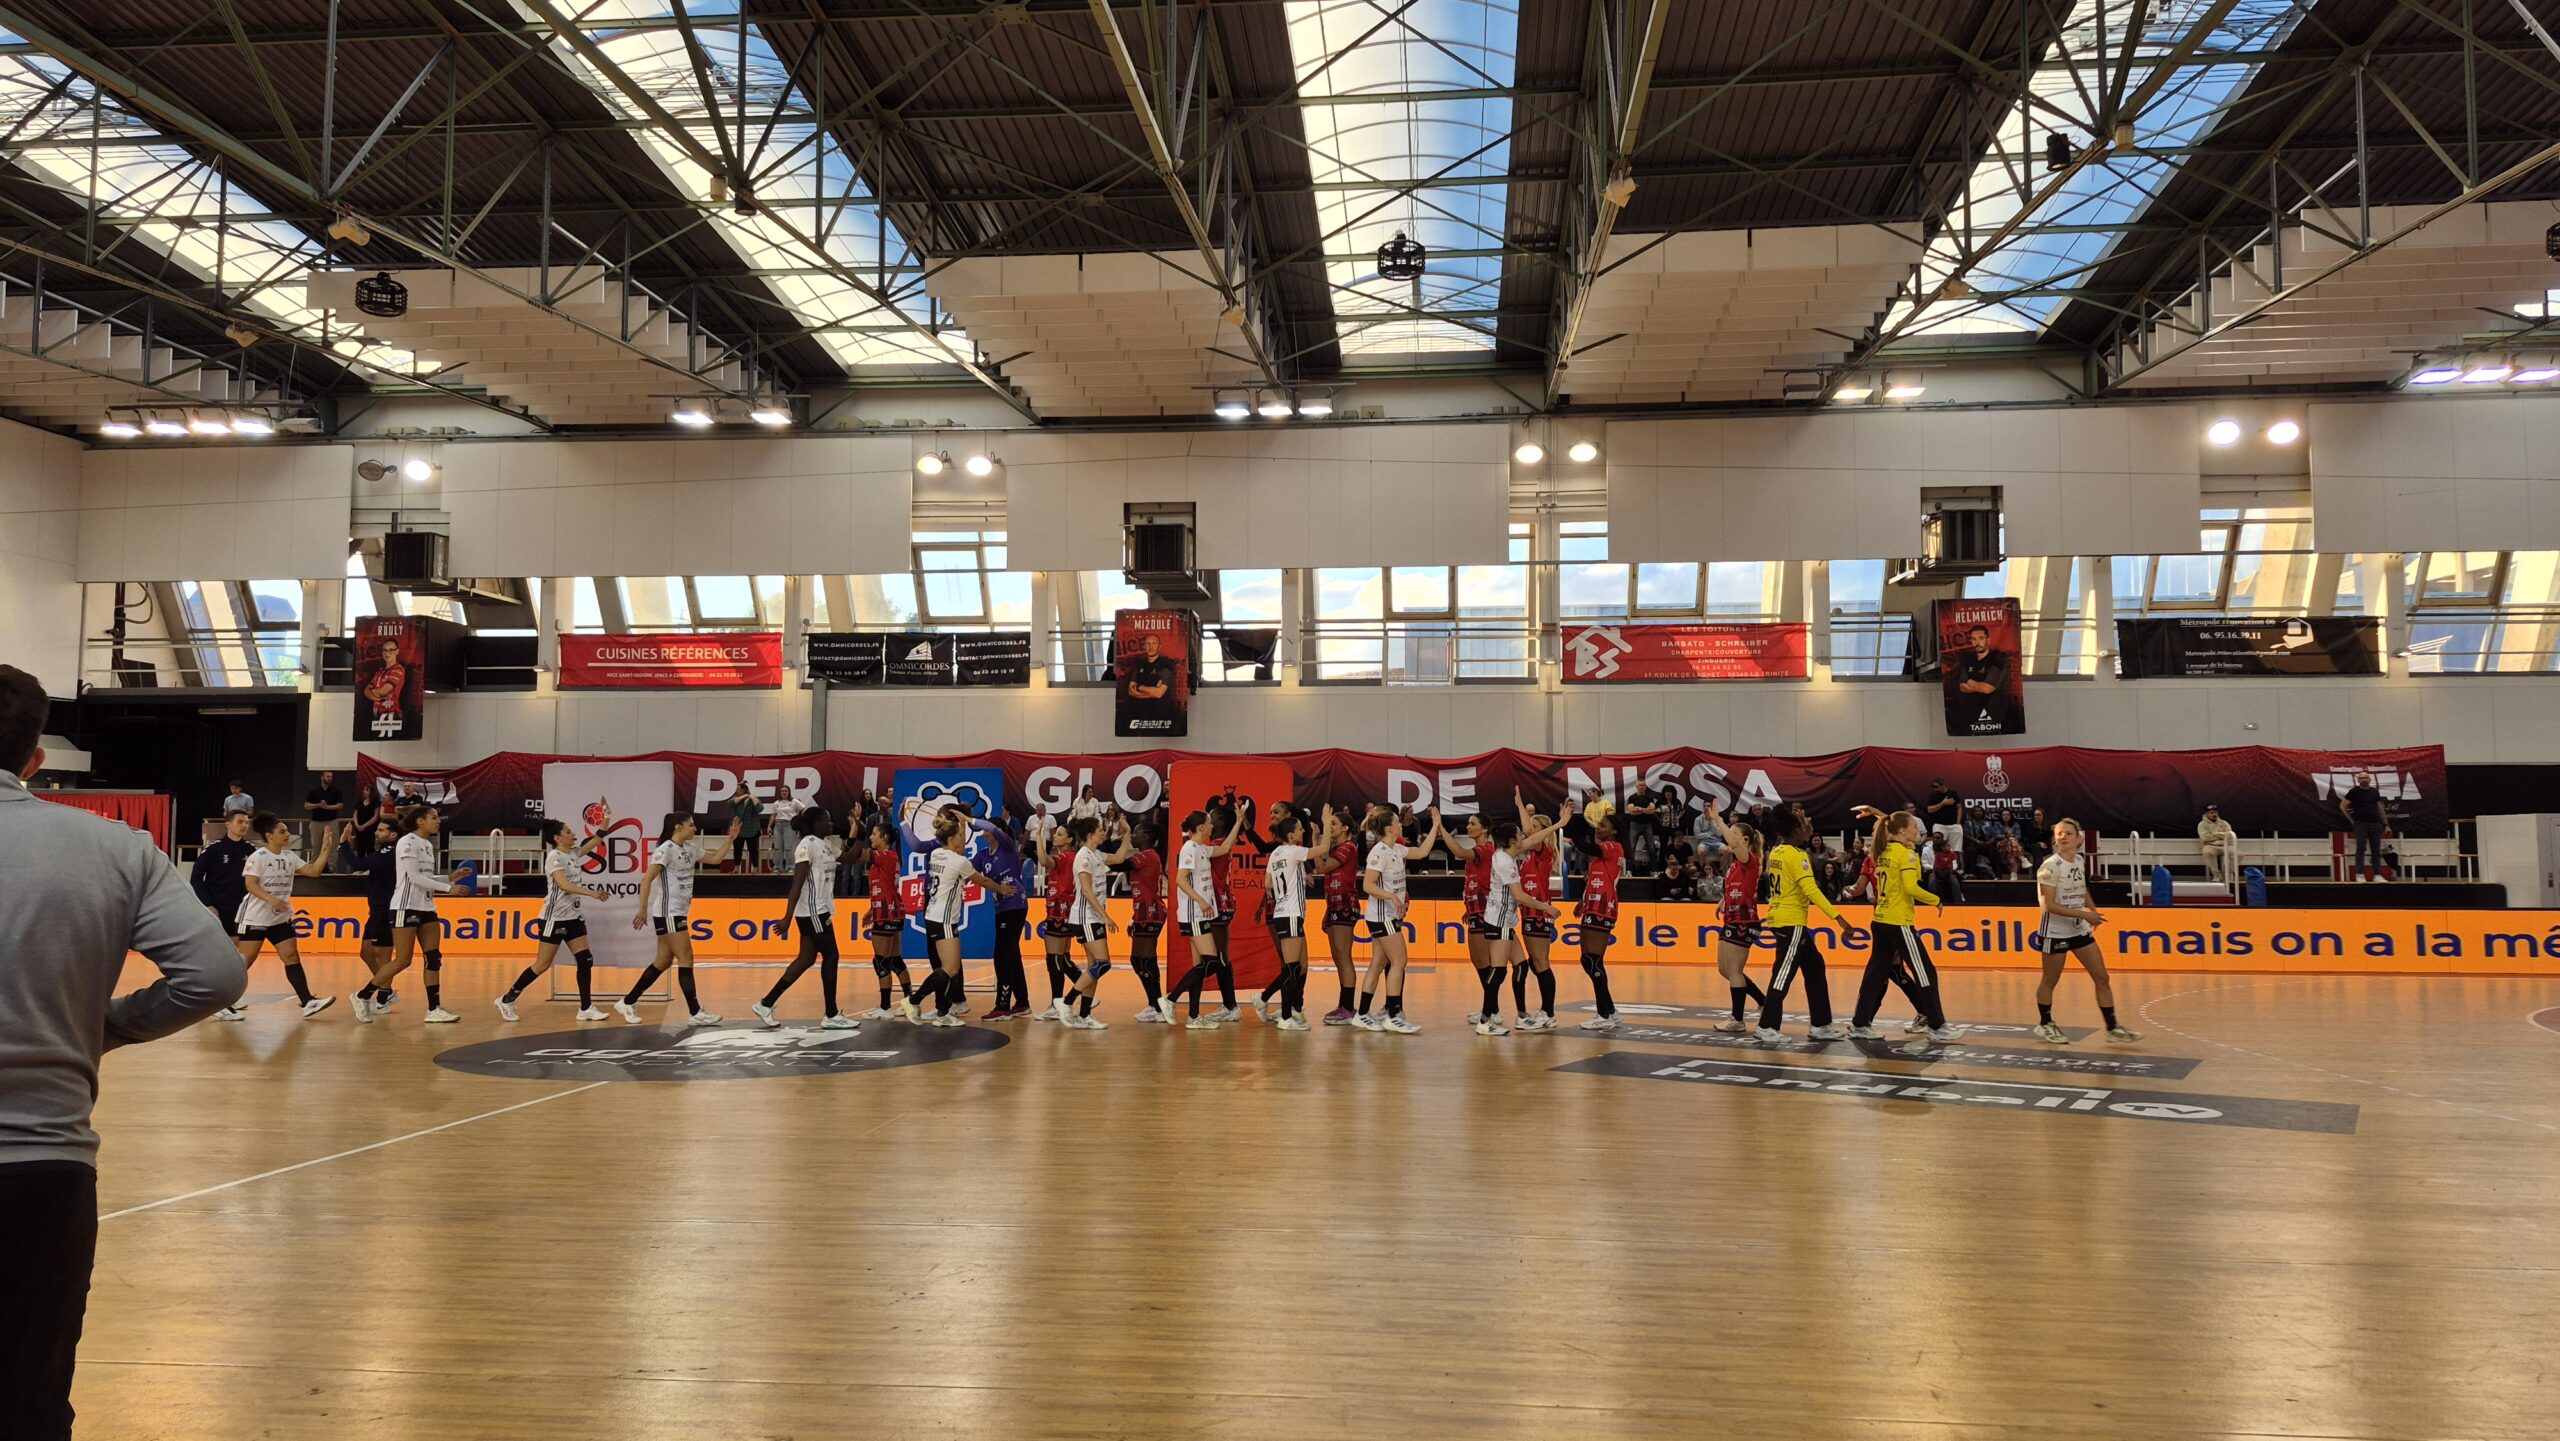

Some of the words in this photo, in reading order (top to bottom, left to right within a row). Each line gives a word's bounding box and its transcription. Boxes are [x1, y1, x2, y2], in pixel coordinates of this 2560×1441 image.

[1955, 610, 2003, 623] HELMRICH
[378, 625, 403, 636] ROULY
[1134, 619, 1172, 630] MIZOULE
[1714, 639, 1769, 647] SCHREIBER
[596, 647, 658, 660] CUISINES
[661, 644, 749, 660] RÉFÉRENCES
[889, 662, 950, 671] OMNICORDES
[1970, 723, 2002, 731] TABONI
[694, 766, 822, 815] PER
[1387, 766, 1480, 816] DE
[1567, 762, 1784, 816] NISSA
[291, 909, 361, 938] êm
[438, 909, 541, 940] aillo
[728, 918, 789, 941] on
[1635, 916, 1680, 948] le
[2118, 921, 2255, 956] mais
[2270, 931, 2344, 956] on
[2363, 932, 2395, 957] a
[2415, 923, 2463, 958] la
[2483, 924, 2560, 959] mê
[1923, 1048, 2155, 1070] Butagaz
